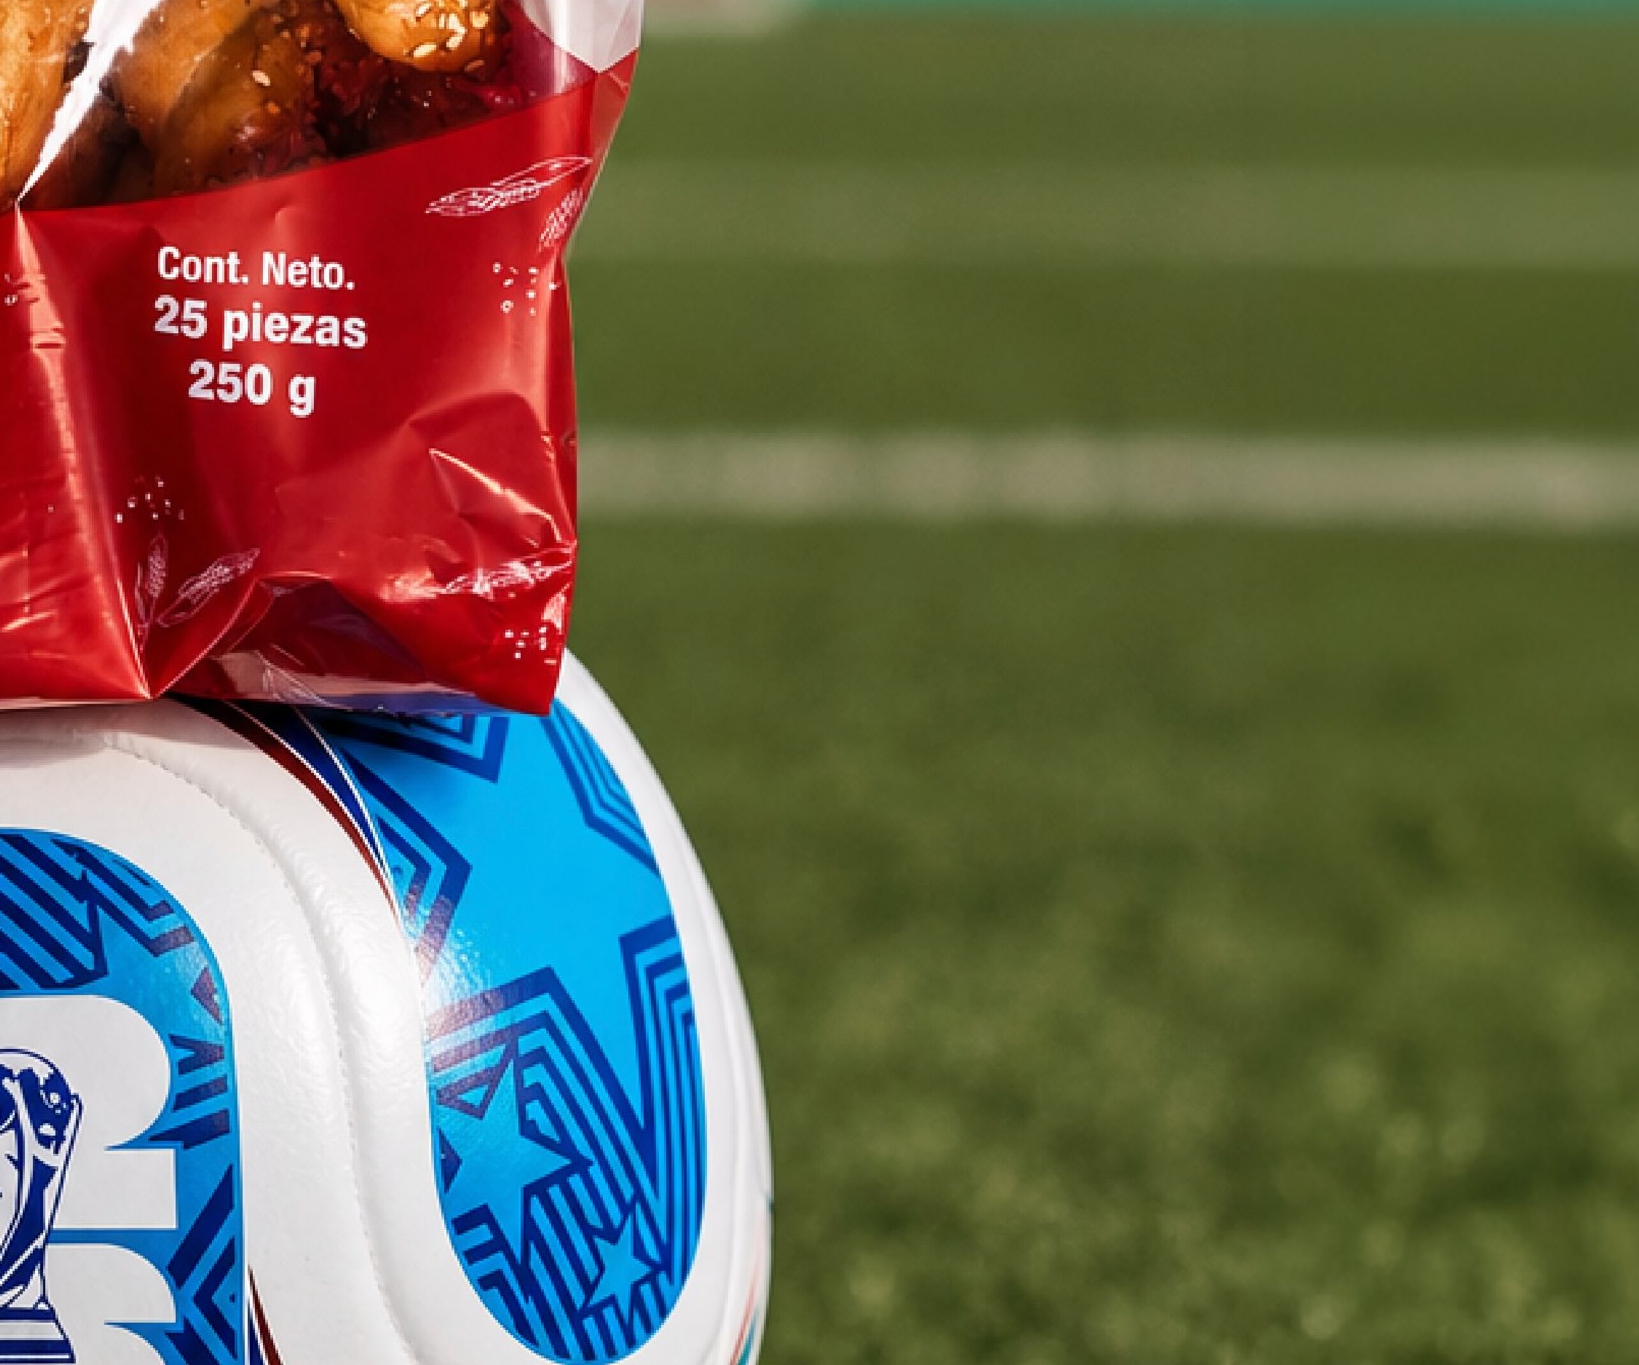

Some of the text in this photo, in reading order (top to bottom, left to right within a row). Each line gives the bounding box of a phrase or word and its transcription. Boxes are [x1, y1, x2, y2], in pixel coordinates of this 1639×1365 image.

[157, 246, 356, 291] Cont. Neto.
[154, 294, 369, 352] 25 piezas
[188, 358, 317, 418] 250 g
